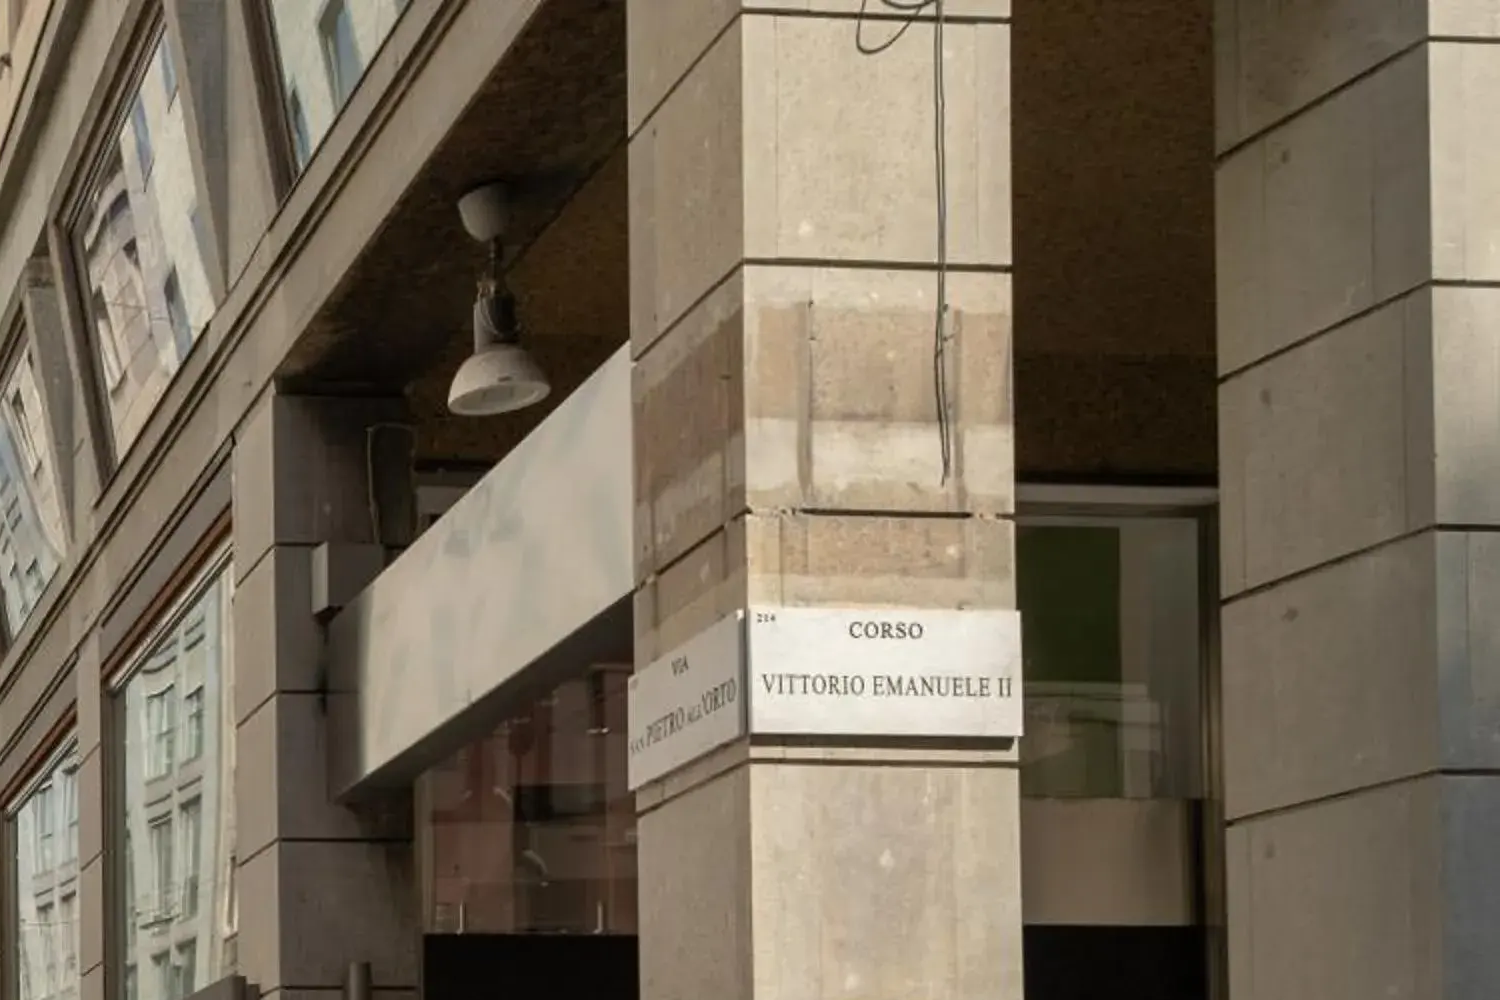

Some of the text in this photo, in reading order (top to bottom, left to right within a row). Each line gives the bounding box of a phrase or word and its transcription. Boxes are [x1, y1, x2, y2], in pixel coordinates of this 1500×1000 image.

[849, 621, 925, 640] CORSO
[671, 655, 689, 677] VIA
[762, 673, 1012, 699] VITTORIO EMANUELE II
[646, 706, 686, 747] PIETRO
